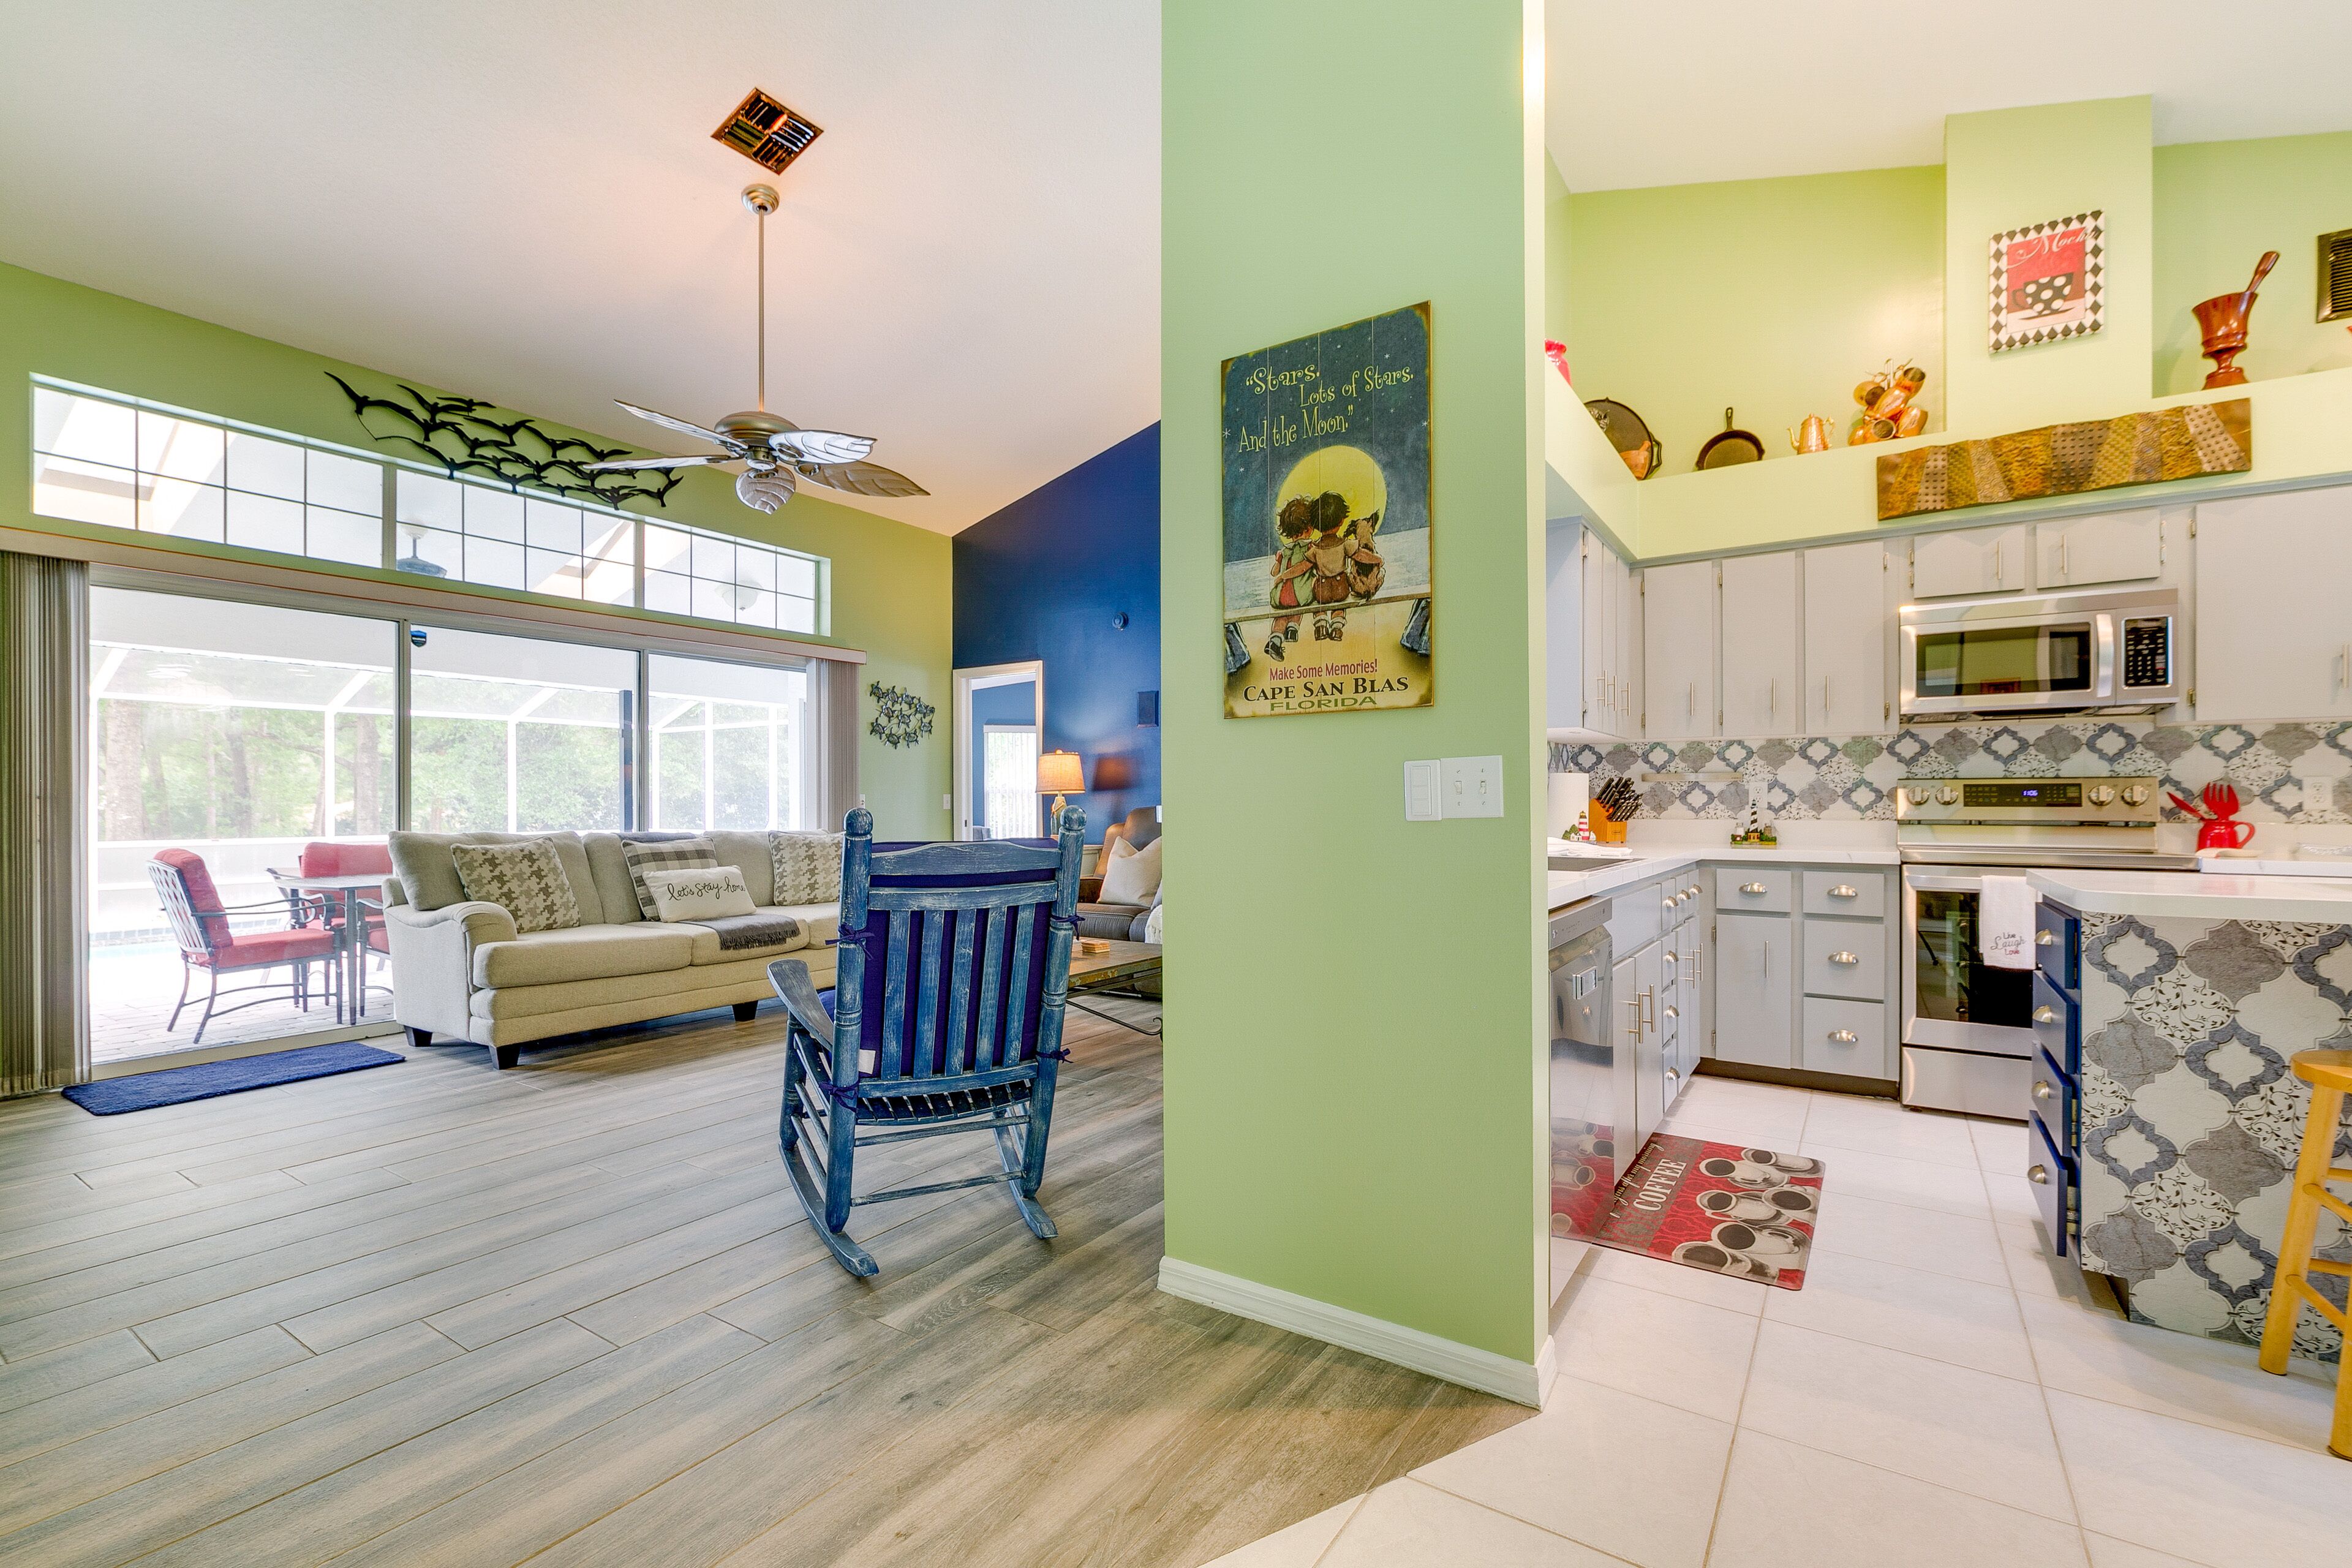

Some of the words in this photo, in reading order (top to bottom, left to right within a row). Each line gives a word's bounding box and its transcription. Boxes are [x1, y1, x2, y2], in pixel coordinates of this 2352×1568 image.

[1300, 380, 1335, 407] Lots
[1341, 371, 1360, 398] of
[1238, 419, 1267, 453] And
[1272, 415, 1297, 447] the
[1270, 667, 1295, 681] Make
[1297, 665, 1323, 679] Some
[1325, 658, 1378, 677] Memories!
[1243, 685, 1295, 702] CAPE
[1303, 681, 1344, 698] SAN
[1353, 676, 1409, 695] BLAS
[1270, 696, 1377, 712] FLORIDA
[1990, 935, 2026, 951] Laugh
[1637, 1142, 1665, 1165] morning
[1631, 1164, 1652, 1174] my
[1633, 1158, 1687, 1211] COFFEE
